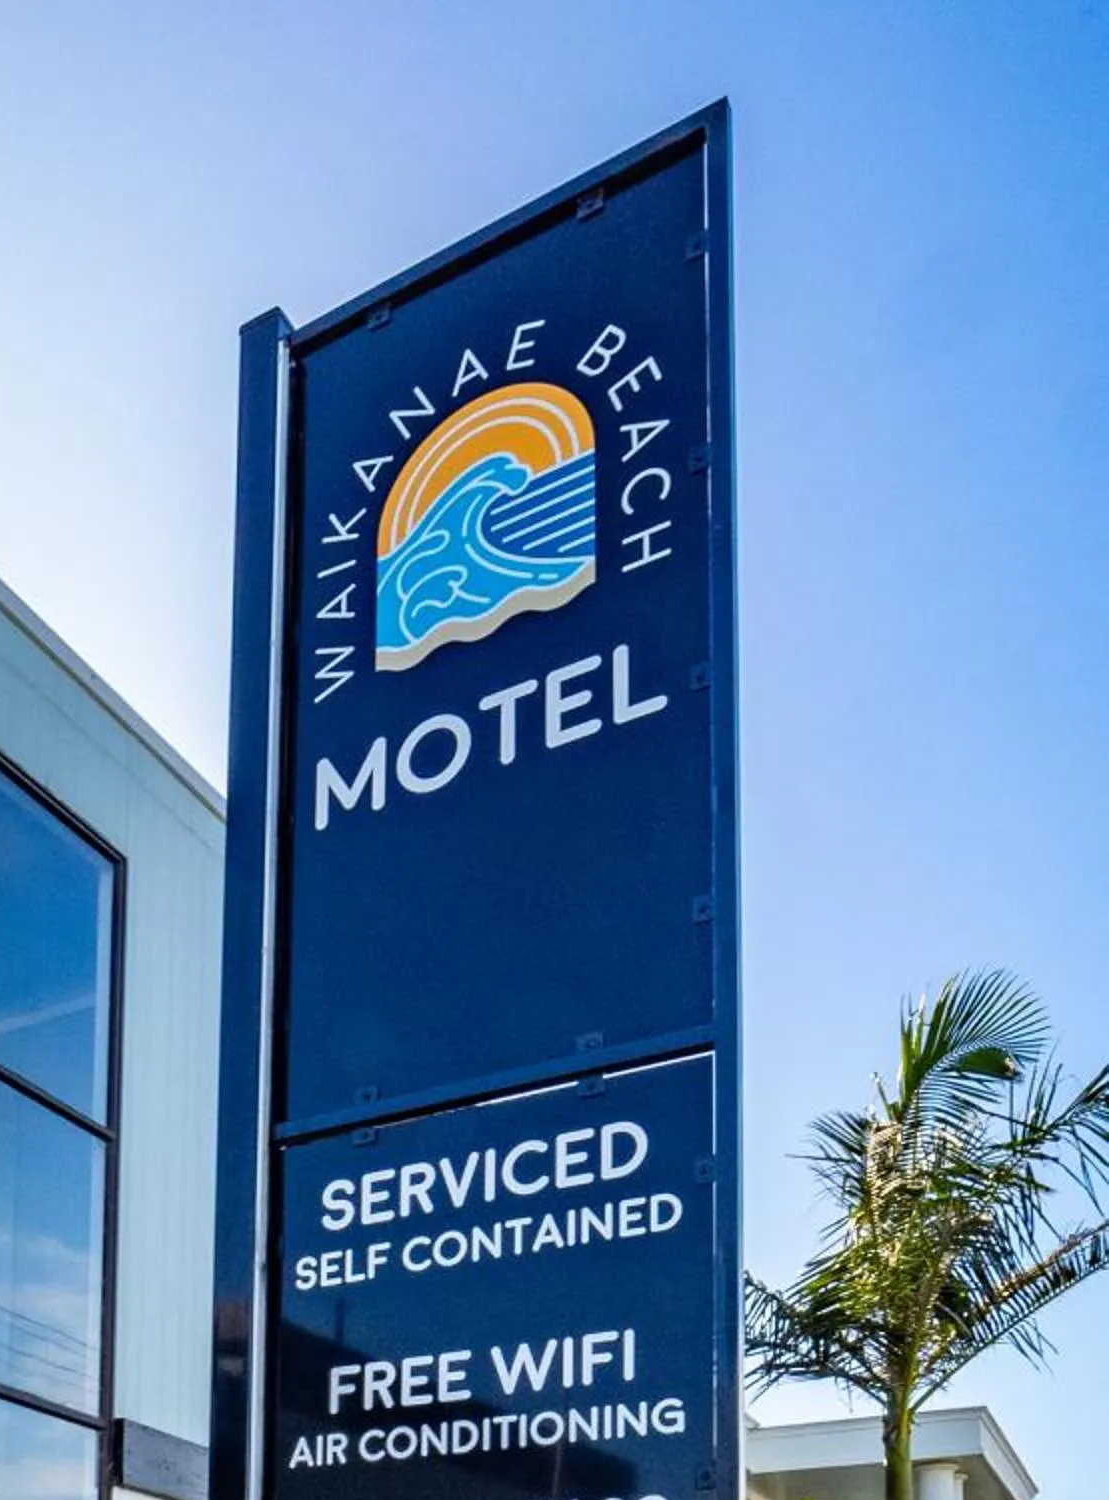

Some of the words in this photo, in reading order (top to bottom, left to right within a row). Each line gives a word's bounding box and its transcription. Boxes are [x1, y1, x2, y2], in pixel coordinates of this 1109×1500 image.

[314, 319, 545, 703] WAIKANAE
[576, 324, 672, 573] BEACH
[314, 644, 668, 831] MOTEL
[321, 1121, 649, 1231] SERVICED
[294, 1241, 391, 1291] SELF
[401, 1193, 684, 1272] CONTAINED
[328, 1349, 473, 1415] FREE
[489, 1328, 636, 1395] WIFI
[288, 1432, 348, 1470] AIR
[357, 1397, 687, 1462] CONDITIONING
